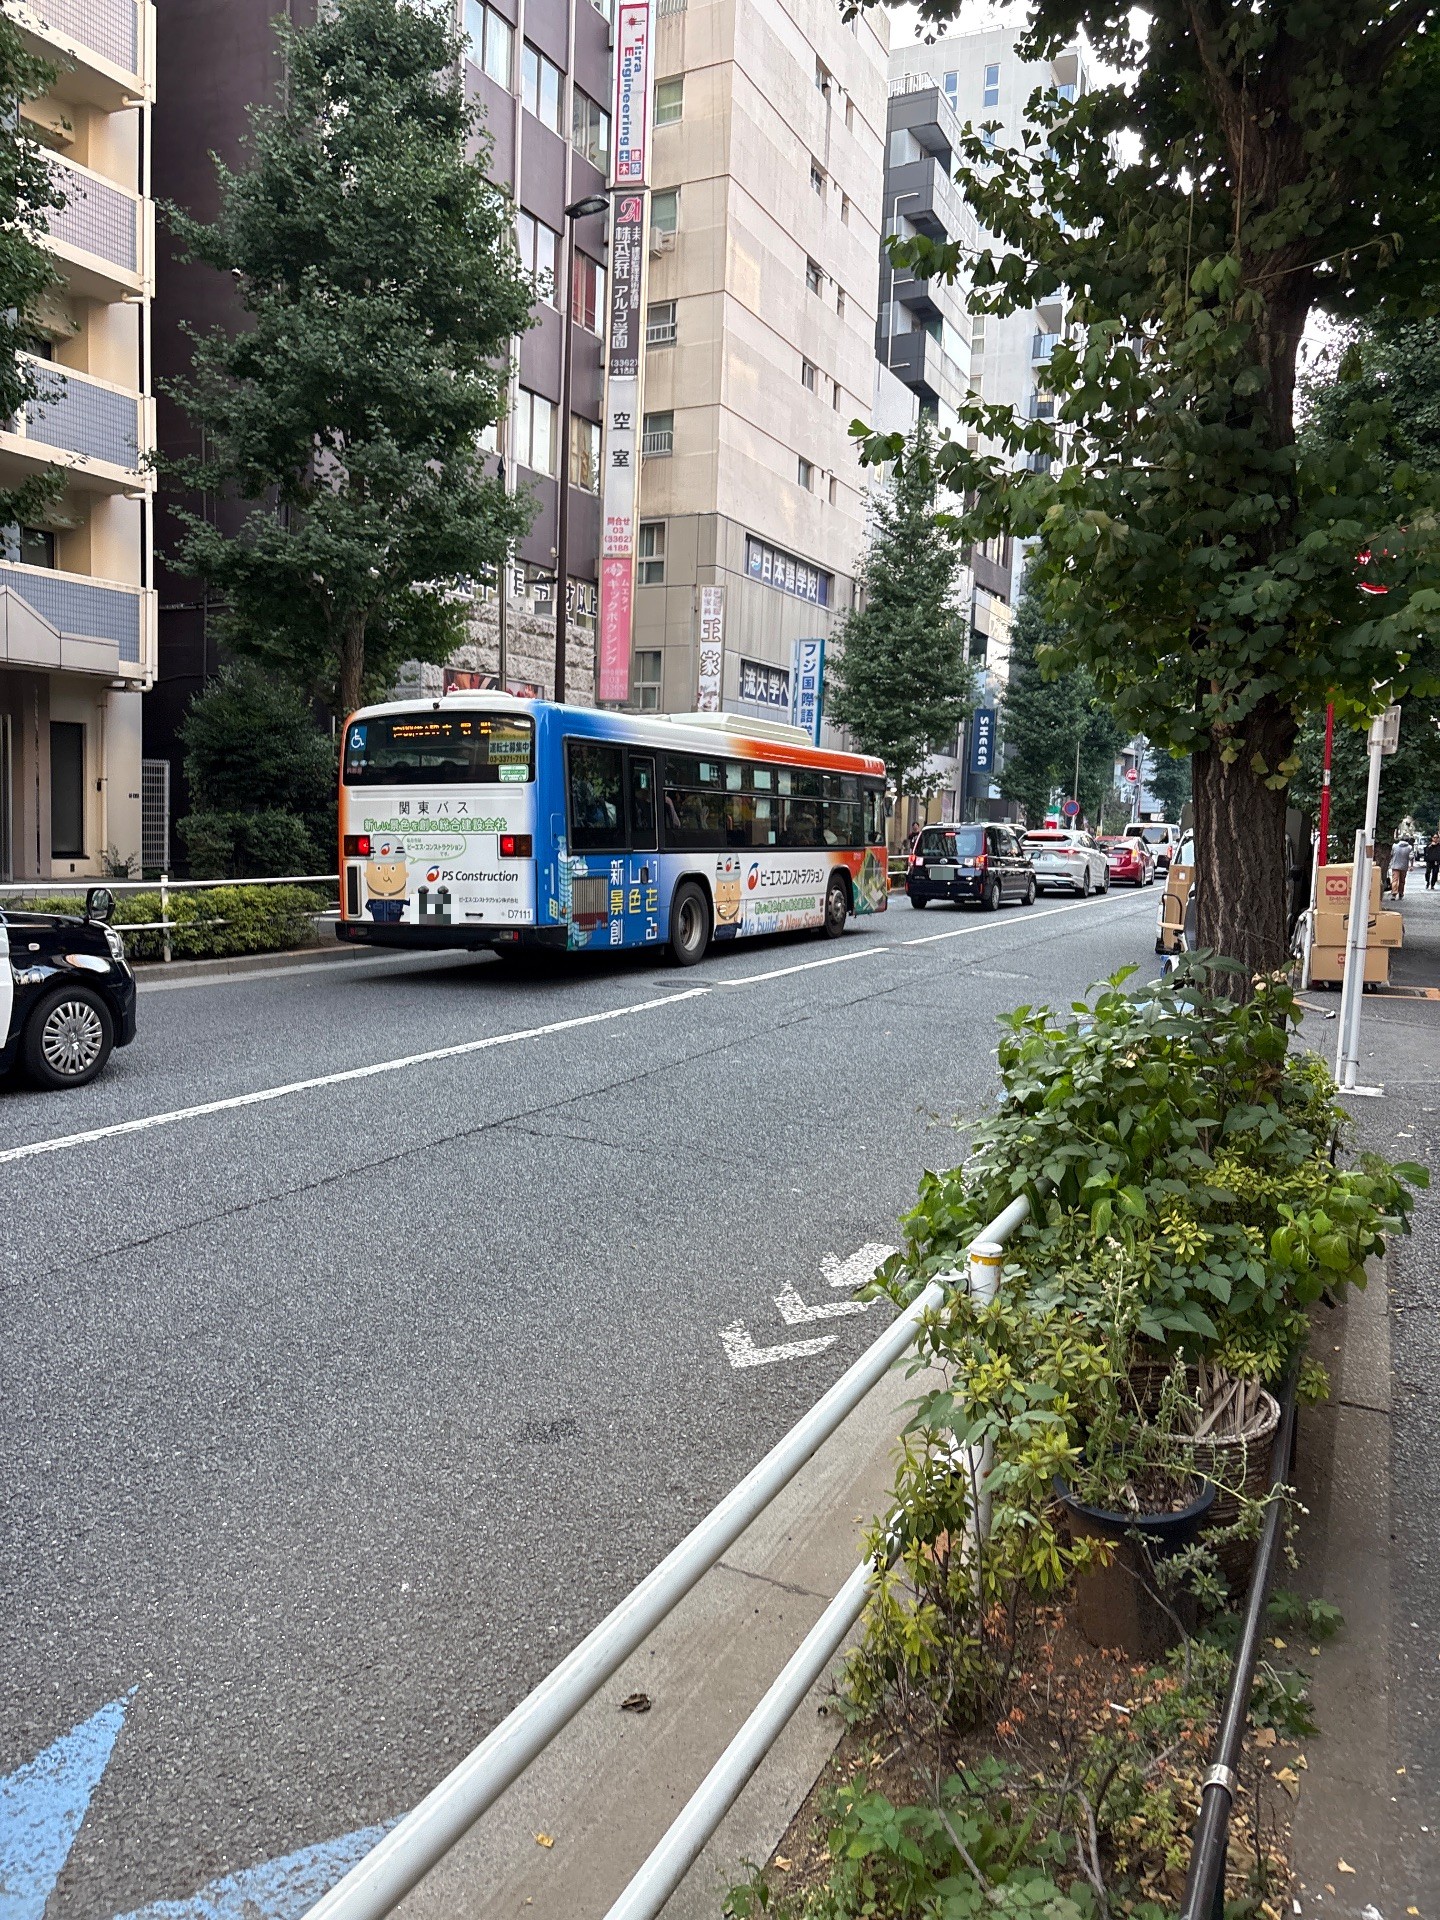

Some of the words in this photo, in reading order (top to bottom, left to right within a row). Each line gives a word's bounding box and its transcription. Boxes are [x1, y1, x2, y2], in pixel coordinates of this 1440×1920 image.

[620, 46, 634, 146] Engineering
[614, 226, 631, 279] 株式会社
[612, 286, 629, 349] アルゴ学園
[611, 412, 631, 468] 空室
[607, 517, 631, 526] 問合せ
[612, 527, 624, 535] 03
[761, 553, 816, 599] 日本語学校
[701, 618, 721, 676] 王家
[977, 716, 989, 766] SHEER
[399, 801, 469, 815] 関東バス
[441, 869, 454, 881] PS
[456, 868, 519, 882] Construction
[508, 909, 531, 919] D7111
